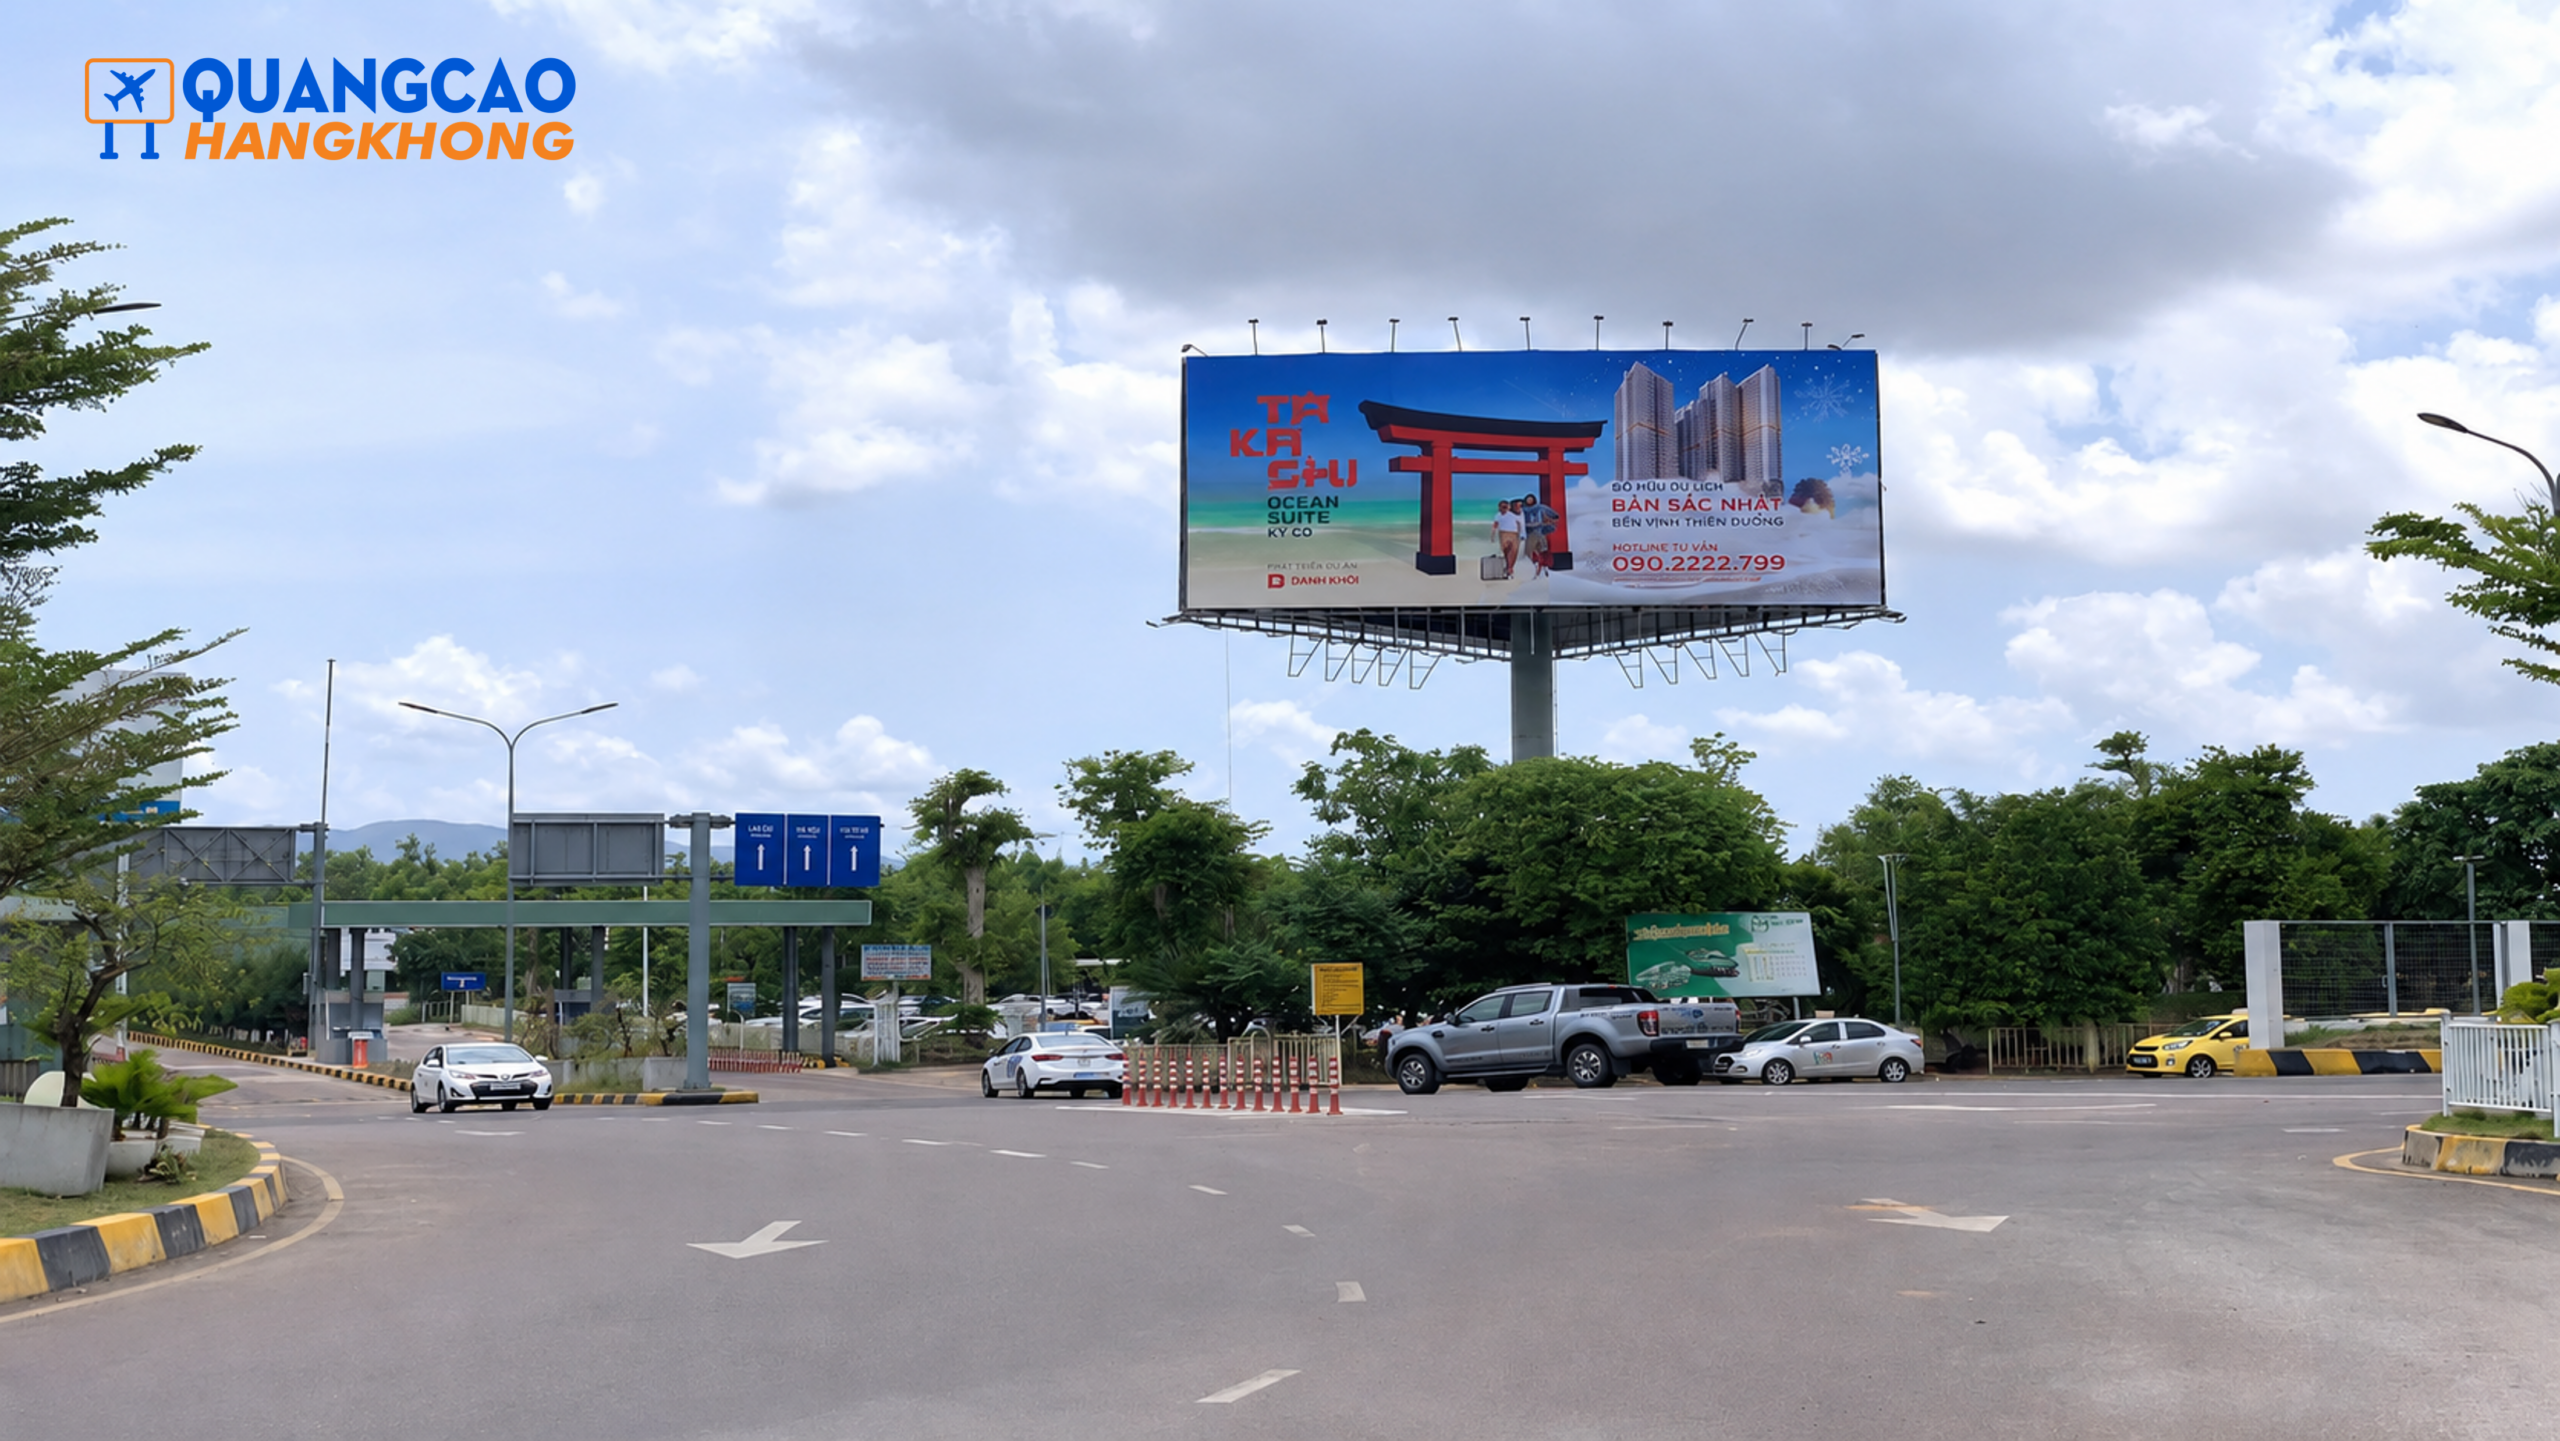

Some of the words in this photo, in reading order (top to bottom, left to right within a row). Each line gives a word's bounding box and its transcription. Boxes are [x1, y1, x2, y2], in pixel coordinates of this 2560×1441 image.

[1230, 428, 1302, 457] KA
[1267, 495, 1339, 510] OCEAN
[1267, 511, 1331, 524] SUITE
[1292, 527, 1313, 538] CO
[1612, 543, 1669, 552] HOTLINE
[1612, 555, 1786, 572] 090.2222.799
[1291, 576, 1326, 586] DANH
